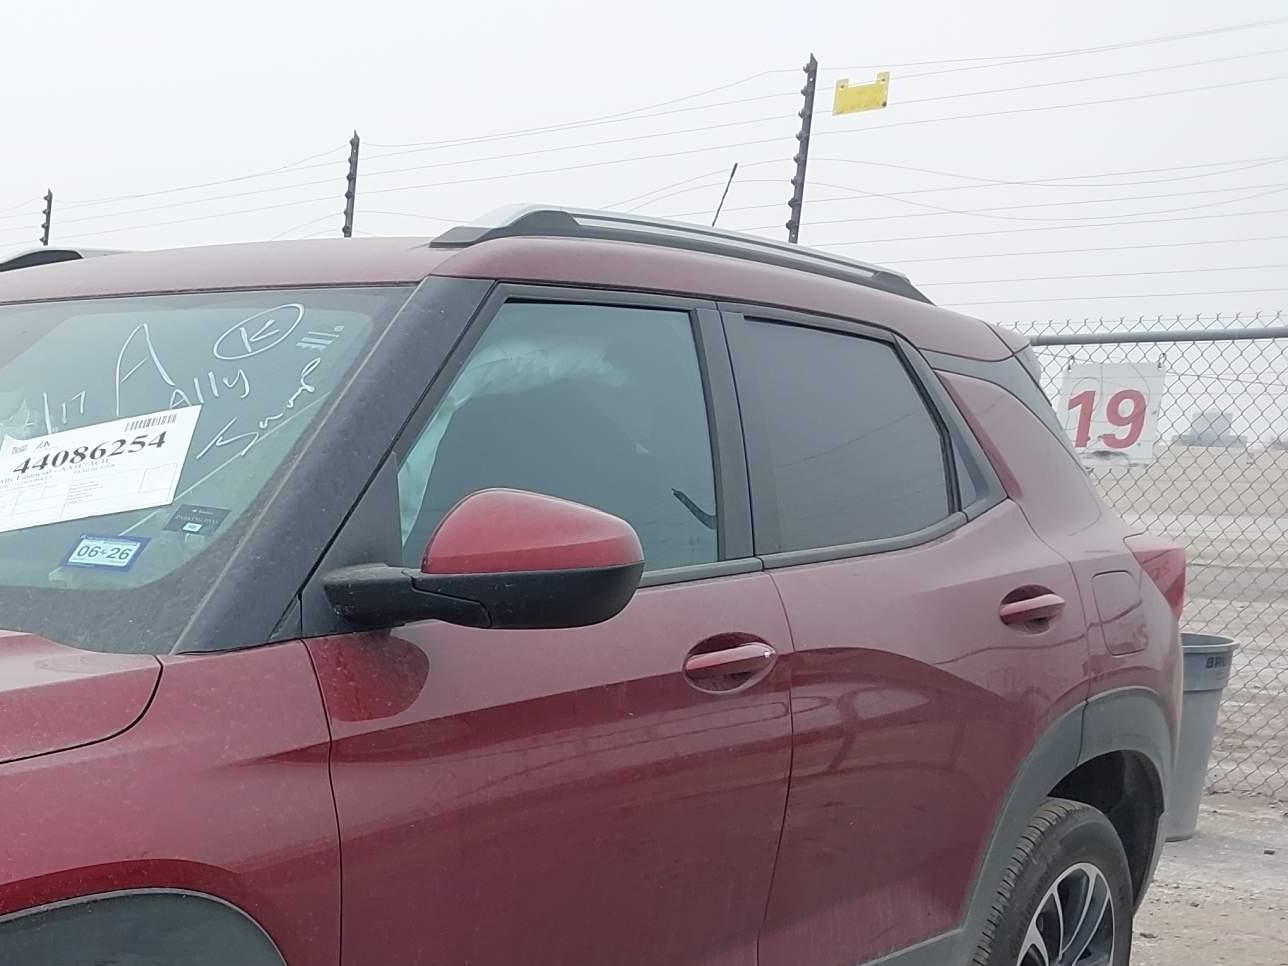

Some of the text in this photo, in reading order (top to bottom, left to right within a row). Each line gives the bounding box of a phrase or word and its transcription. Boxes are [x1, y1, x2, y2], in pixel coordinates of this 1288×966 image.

[115, 322, 176, 416] A
[169, 369, 250, 409] Ally
[1068, 389, 1147, 449] 19
[13, 430, 168, 474] 44086254
